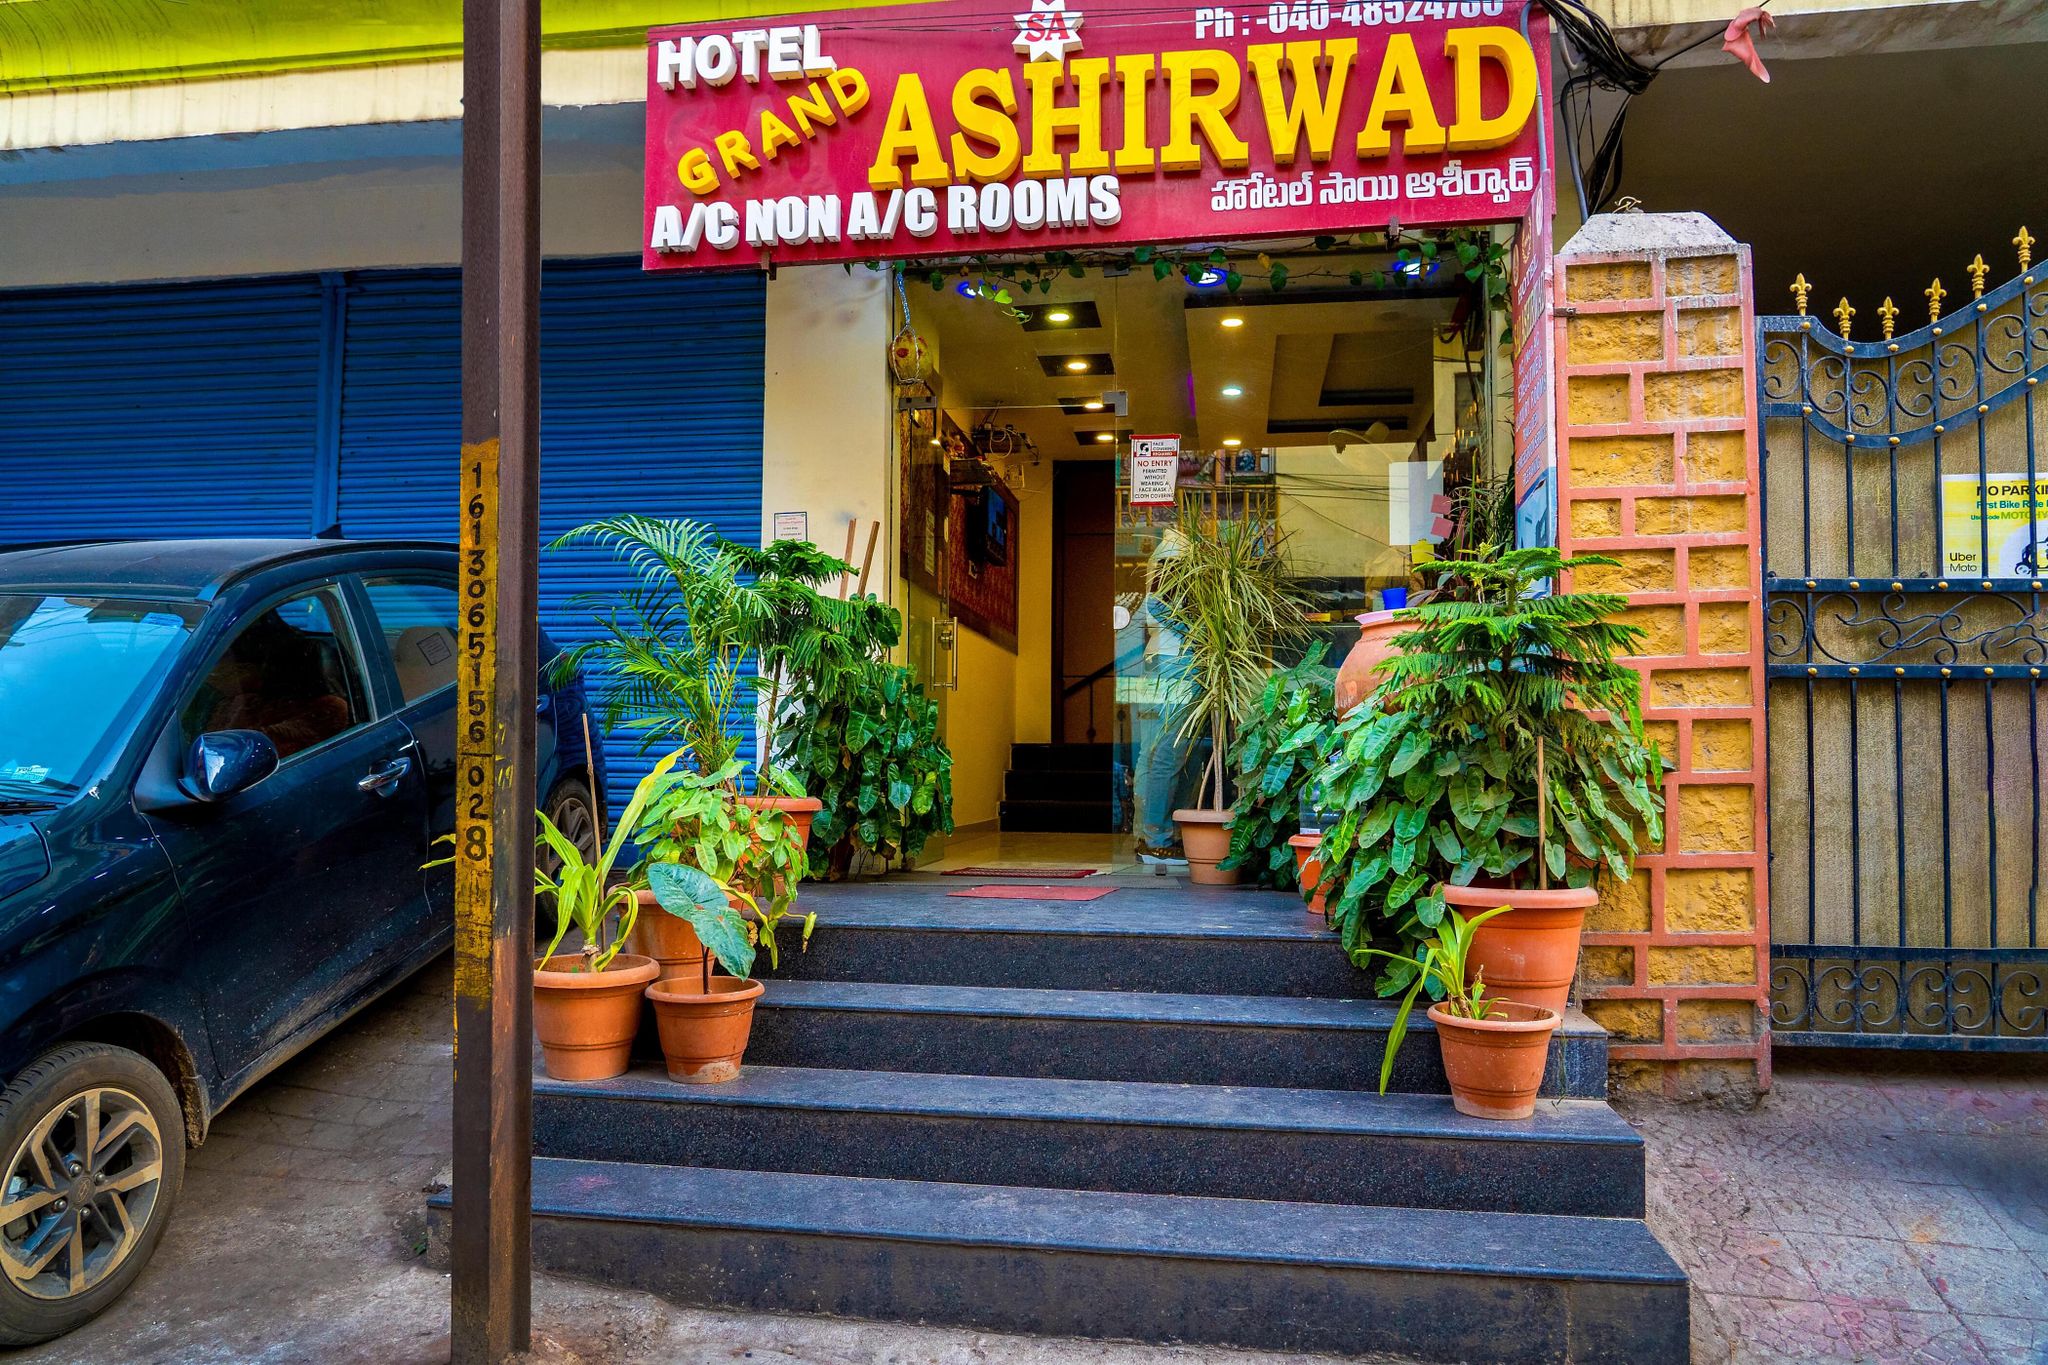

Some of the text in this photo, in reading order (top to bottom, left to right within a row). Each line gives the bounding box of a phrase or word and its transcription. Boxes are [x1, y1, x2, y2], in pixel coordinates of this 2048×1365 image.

[1025, 11, 1070, 42] SA
[1196, 7, 1234, 39] Ph
[657, 24, 837, 91] HOTEL
[677, 26, 1538, 195] GRAND ASHIRWAD
[1319, 172, 1398, 205] సాయి
[650, 174, 1122, 253] A/C NON A/C ROOMS
[2000, 500, 2020, 509] Bike
[1949, 552, 1977, 562] Uber
[1949, 563, 1977, 572] Moto
